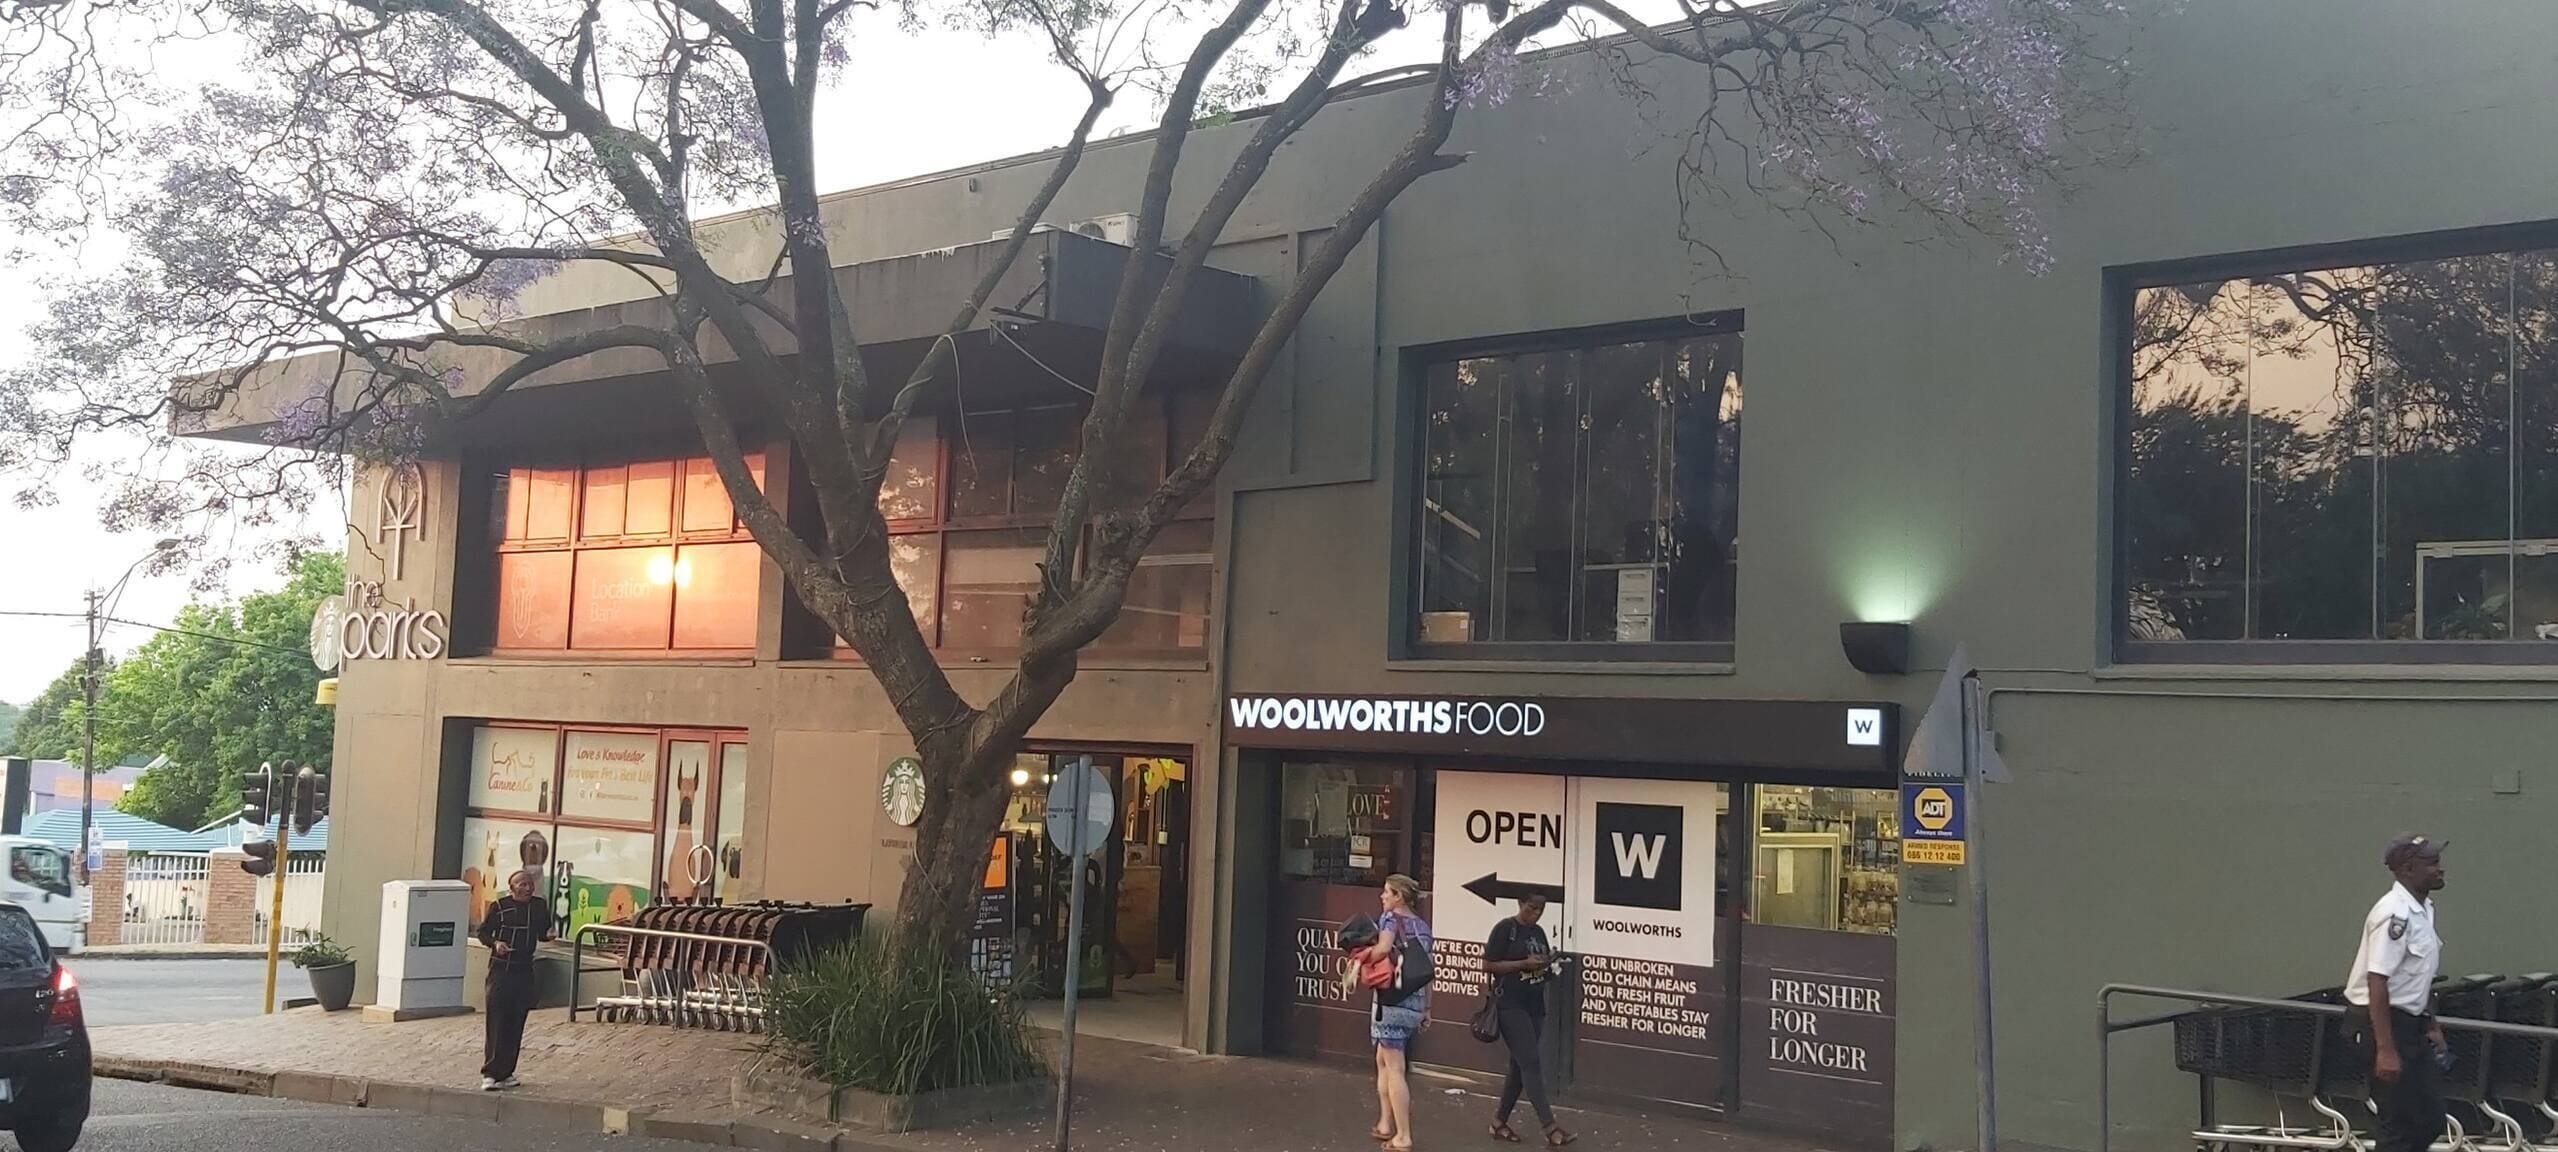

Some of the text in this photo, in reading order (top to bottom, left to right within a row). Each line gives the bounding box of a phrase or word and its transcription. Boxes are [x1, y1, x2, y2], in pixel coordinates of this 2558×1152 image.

[345, 573, 379, 608] the
[339, 597, 444, 671] parks
[1230, 698, 1545, 736] WOOLWORTHS FOOD
[1855, 720, 1873, 733] W
[603, 747, 646, 765] Knowledge
[1922, 802, 1946, 816] ADT
[1466, 809, 1562, 849] OPEN
[1611, 831, 1668, 880] W
[1924, 851, 1933, 860] 12
[1935, 852, 1945, 860] 12
[1593, 919, 1682, 938] WOOLWORTHS
[1296, 951, 1331, 975] YOU
[1582, 955, 1674, 976] OUR UNBROKEN
[1460, 970, 1488, 983] WITH
[1582, 970, 1697, 994] COLD CHAIN MEANS
[1582, 984, 1686, 1007] YOUR FRESH FRUIT
[1770, 978, 1882, 1013] FRESHER
[1581, 998, 1710, 1024] AND VEGETABLES STAY
[1769, 1007, 1818, 1035] FOR
[1581, 1011, 1707, 1040] FRESHER FOR LONGER
[1769, 1036, 1867, 1072] LONGER
